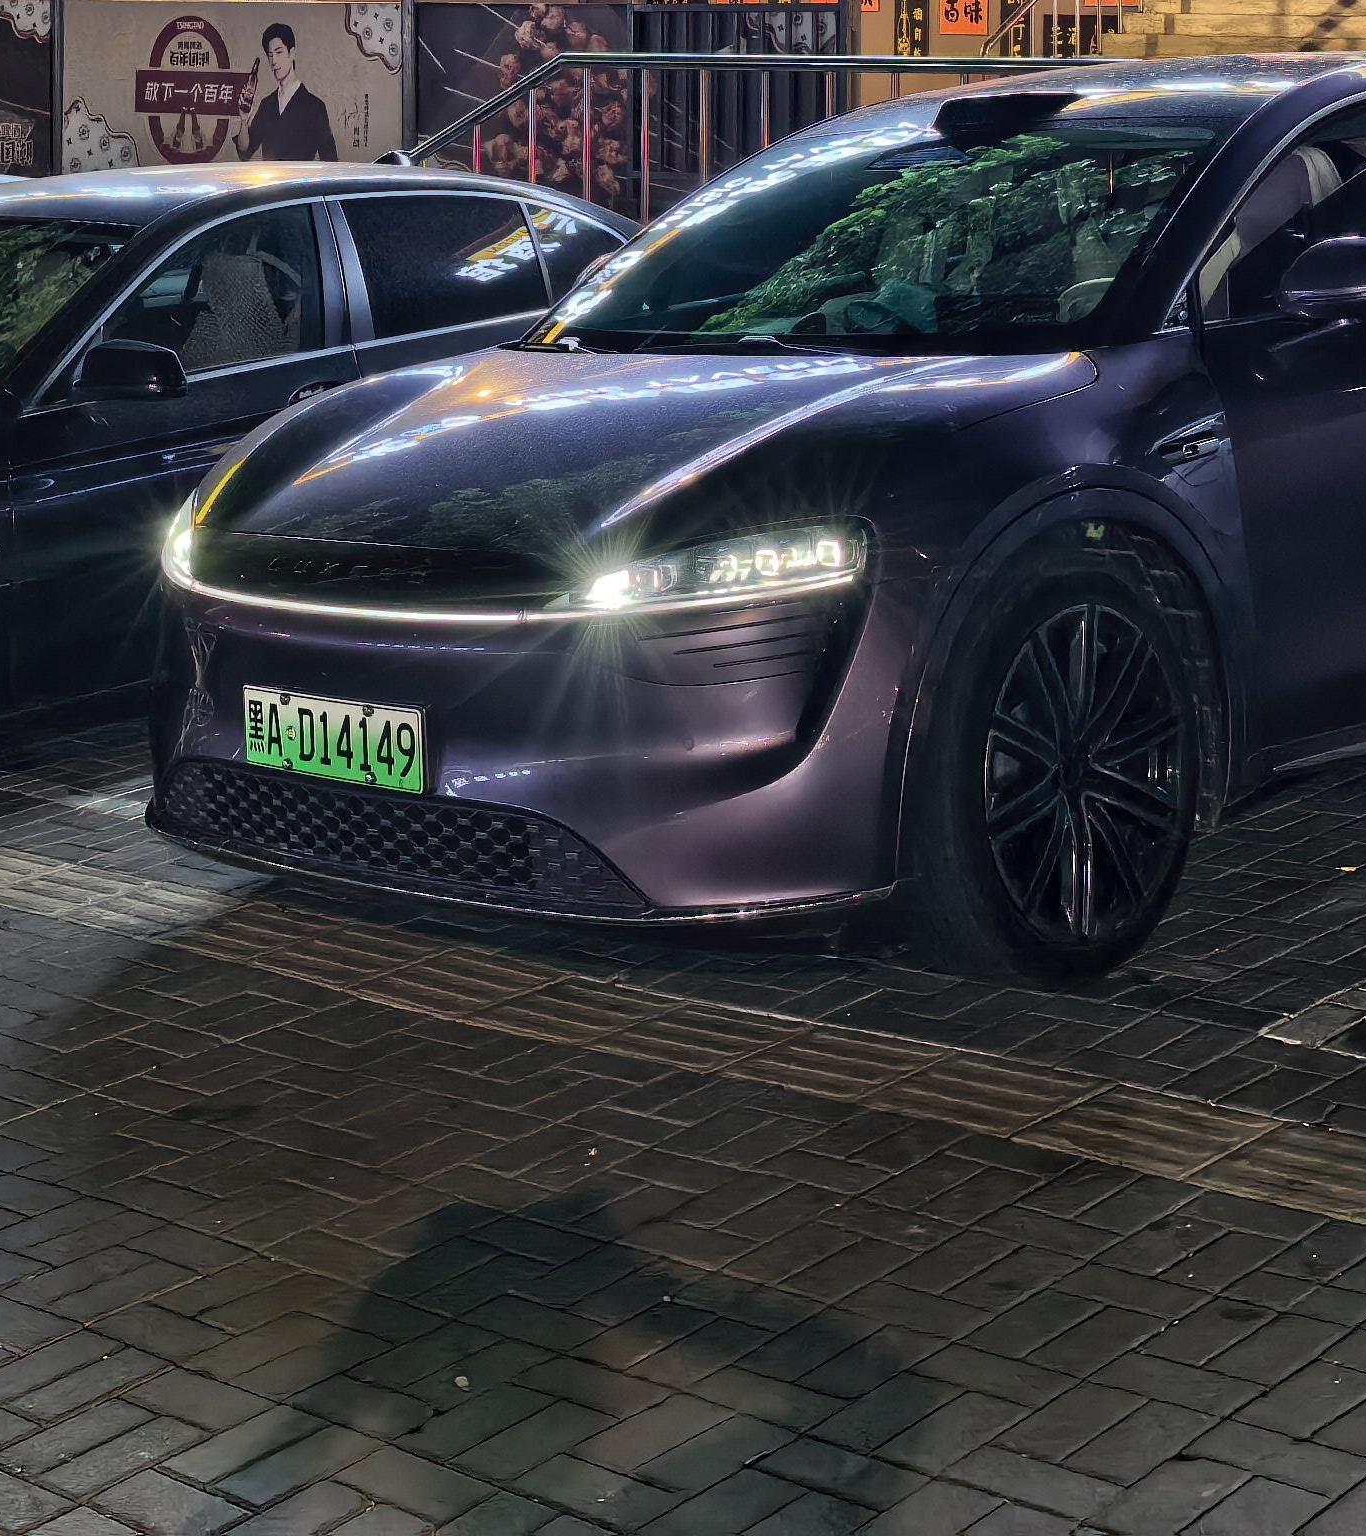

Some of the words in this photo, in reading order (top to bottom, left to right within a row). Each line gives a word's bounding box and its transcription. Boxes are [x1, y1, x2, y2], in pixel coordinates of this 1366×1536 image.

[144, 80, 235, 104] 敬下一个百年
